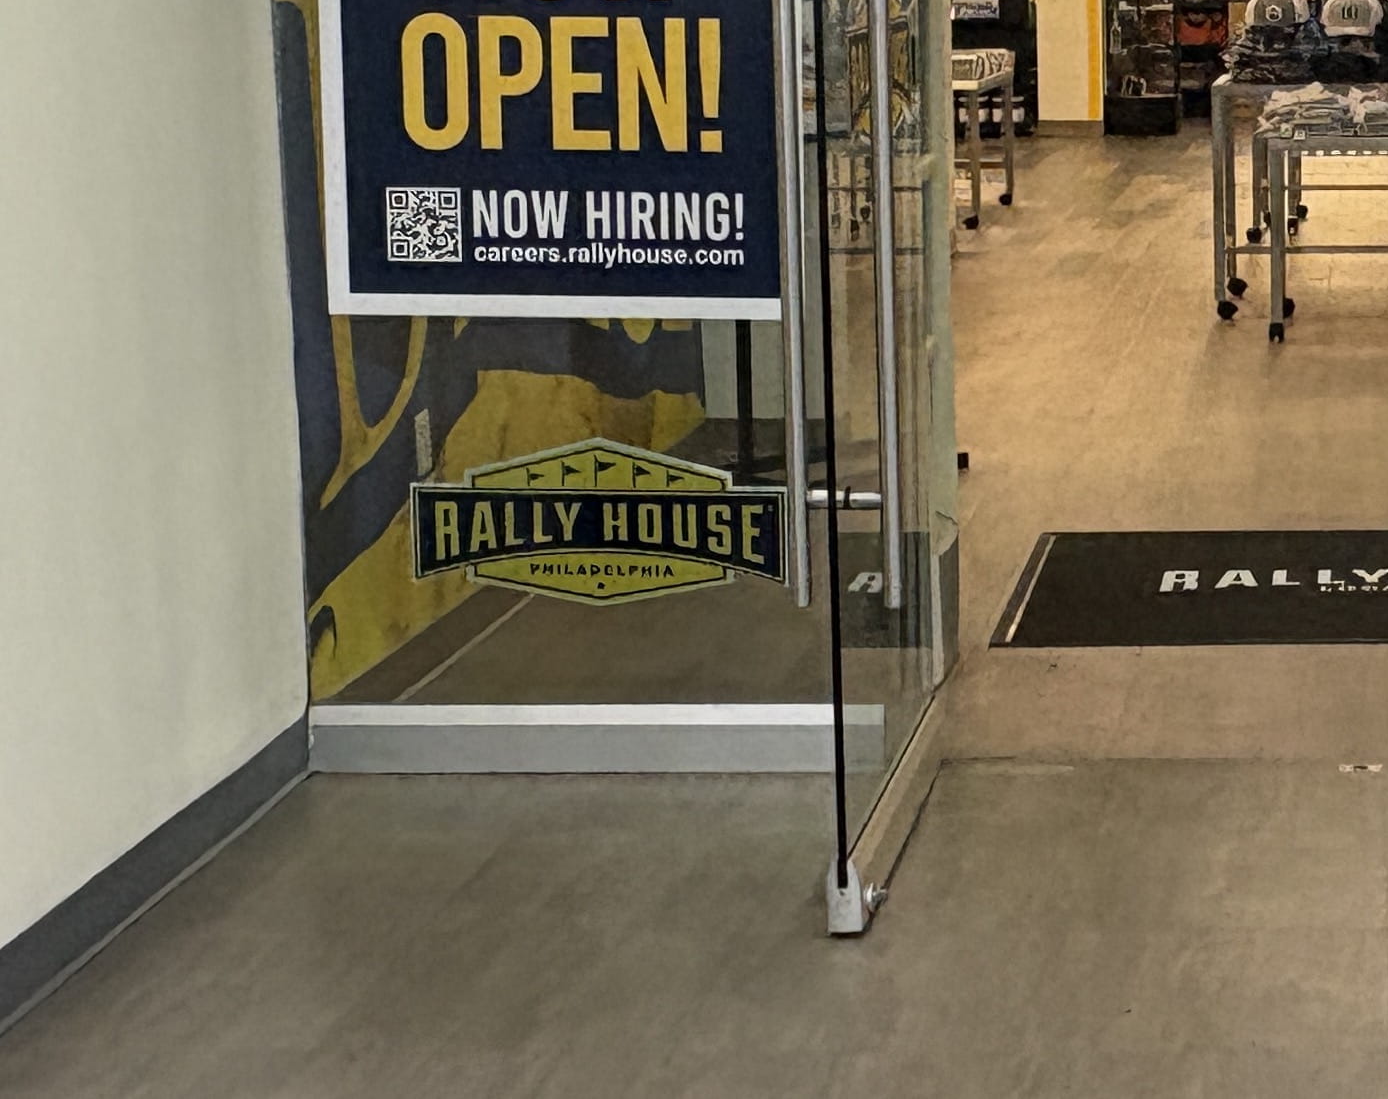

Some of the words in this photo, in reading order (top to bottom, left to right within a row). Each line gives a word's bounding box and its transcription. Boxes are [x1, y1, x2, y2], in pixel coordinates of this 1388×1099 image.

[401, 12, 723, 153] OPEN!
[472, 189, 569, 239] NOW
[585, 190, 745, 242] HIRING!
[473, 242, 745, 270] careers.rallyhouse.com
[433, 500, 582, 561] RALLY
[602, 501, 766, 565] HOUSE
[529, 562, 676, 578] PHILADELPHIA
